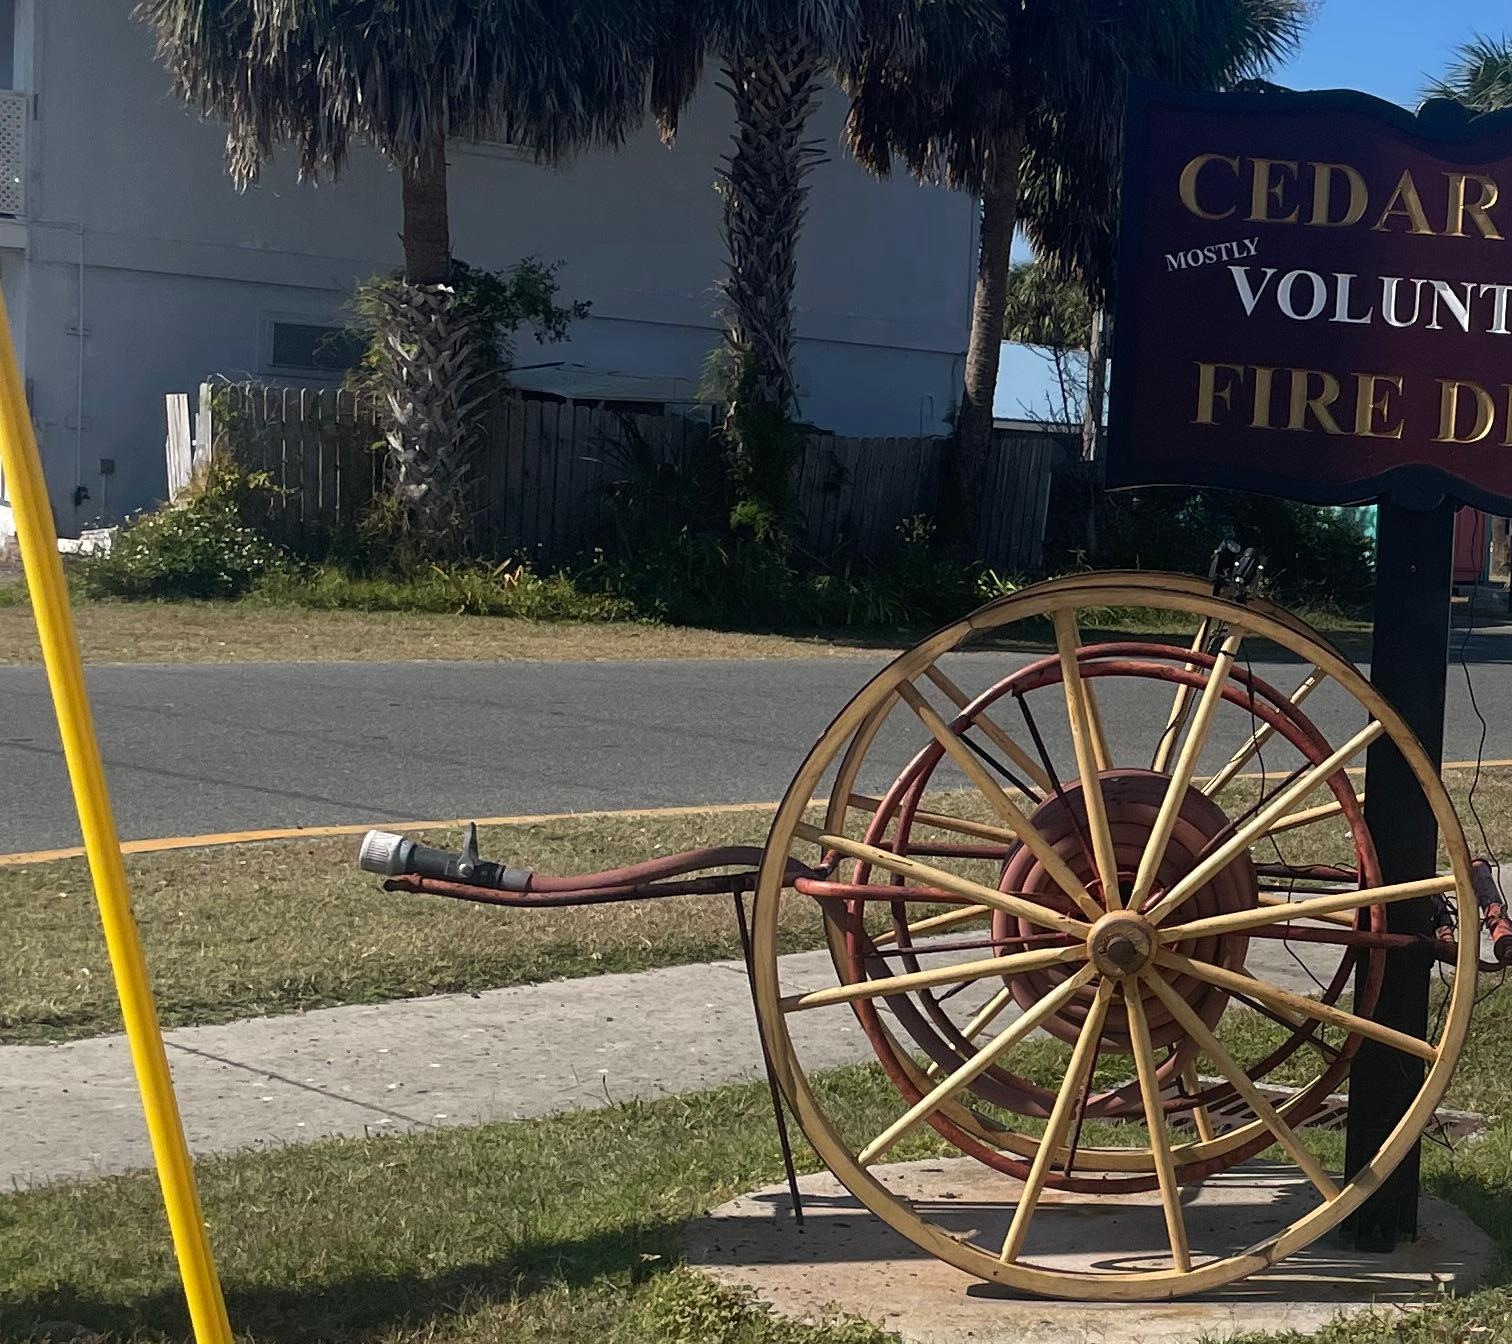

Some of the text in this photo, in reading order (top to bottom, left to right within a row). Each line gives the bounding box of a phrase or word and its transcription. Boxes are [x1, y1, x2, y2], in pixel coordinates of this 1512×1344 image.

[1179, 154, 1504, 240] CEDAR
[1165, 237, 1259, 272] MOSTLY
[1193, 362, 1405, 439] FIRE
